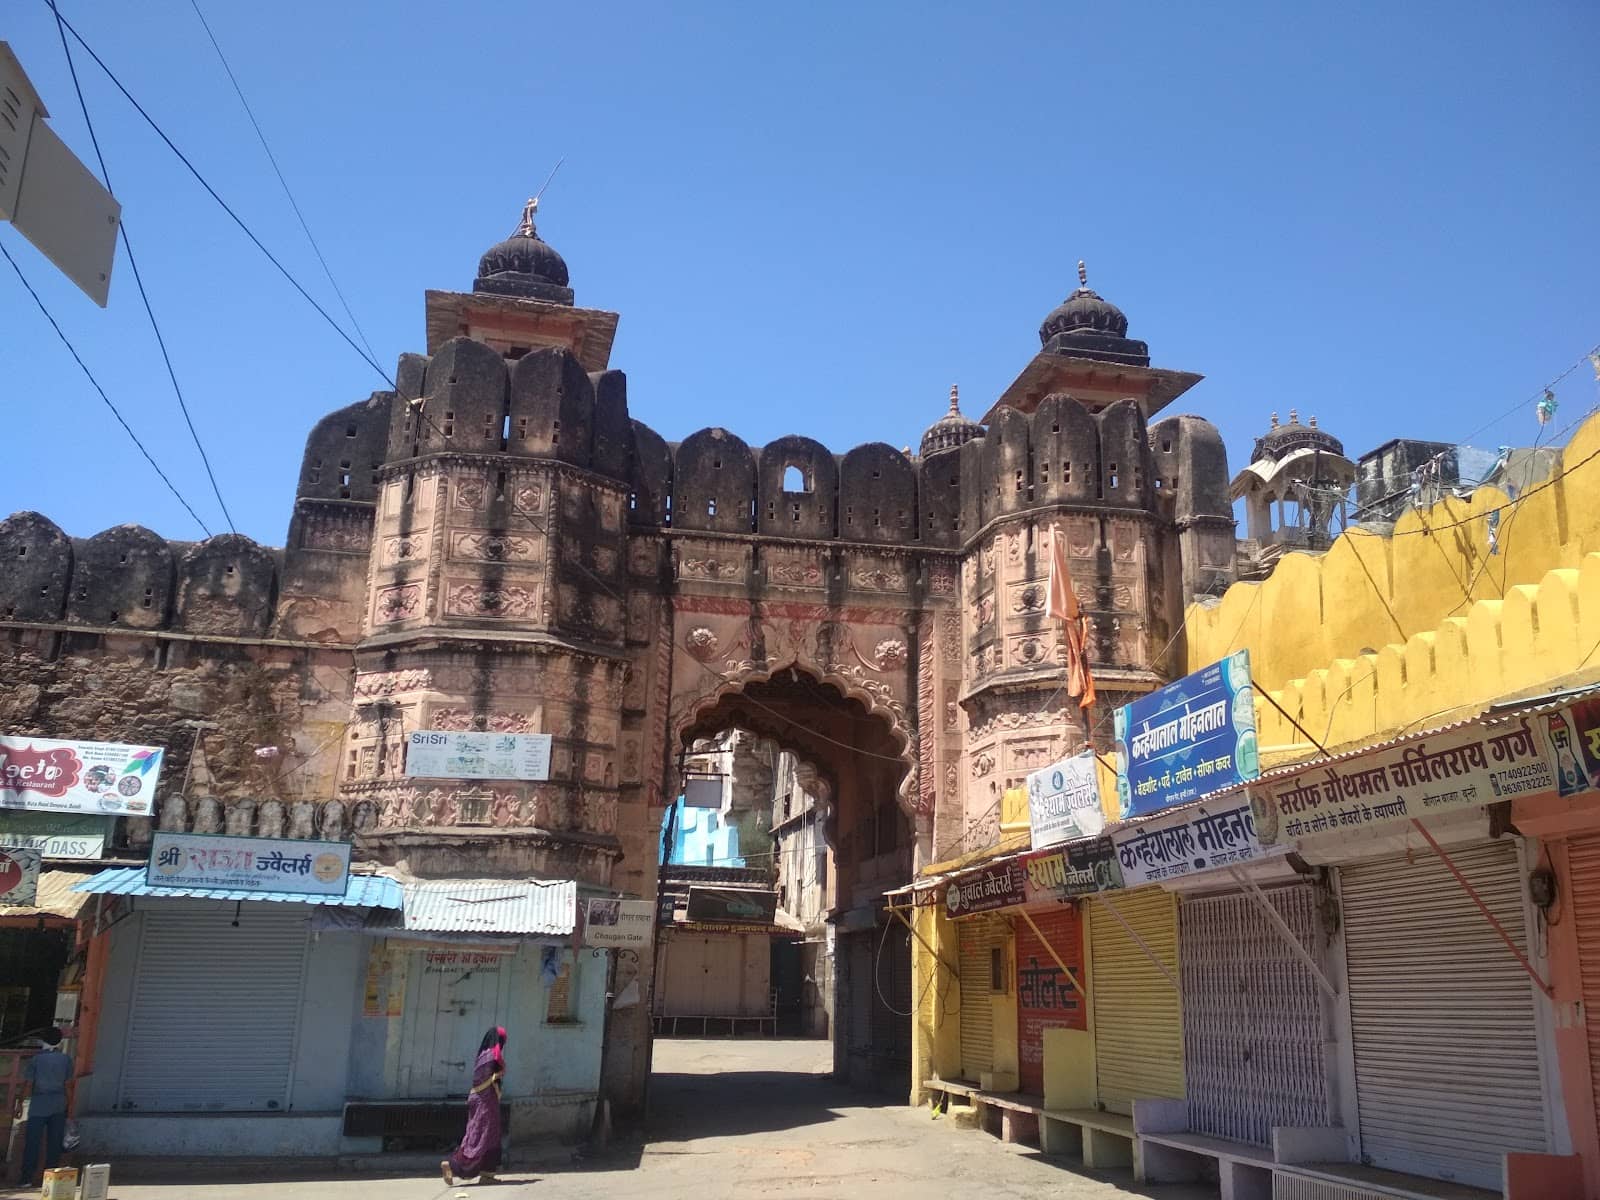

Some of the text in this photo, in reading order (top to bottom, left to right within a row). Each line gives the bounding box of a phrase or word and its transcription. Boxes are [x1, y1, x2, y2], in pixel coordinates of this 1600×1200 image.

[1132, 700, 1227, 759] कन्हैयालाल मोहनलाल
[1322, 767, 1390, 802] चौथमल
[1487, 716, 1538, 762] गर्ग
[1498, 762, 1548, 781] 7740922500
[1501, 776, 1552, 796] 9636782225
[1310, 813, 1328, 832] सोने
[1327, 810, 1338, 828] के
[1361, 803, 1373, 821] के
[1372, 795, 1408, 819] व्यापारी
[50, 840, 87, 856] DASS
[158, 846, 181, 867] श्री
[256, 850, 313, 876] ज्वैलर्स
[1117, 824, 1195, 871] कन्हैयालाल
[984, 865, 1013, 897] ज्वैलर्स
[1027, 854, 1067, 891] श्याम
[1065, 862, 1096, 885] ज्वैलर्स
[626, 934, 643, 943] Gate
